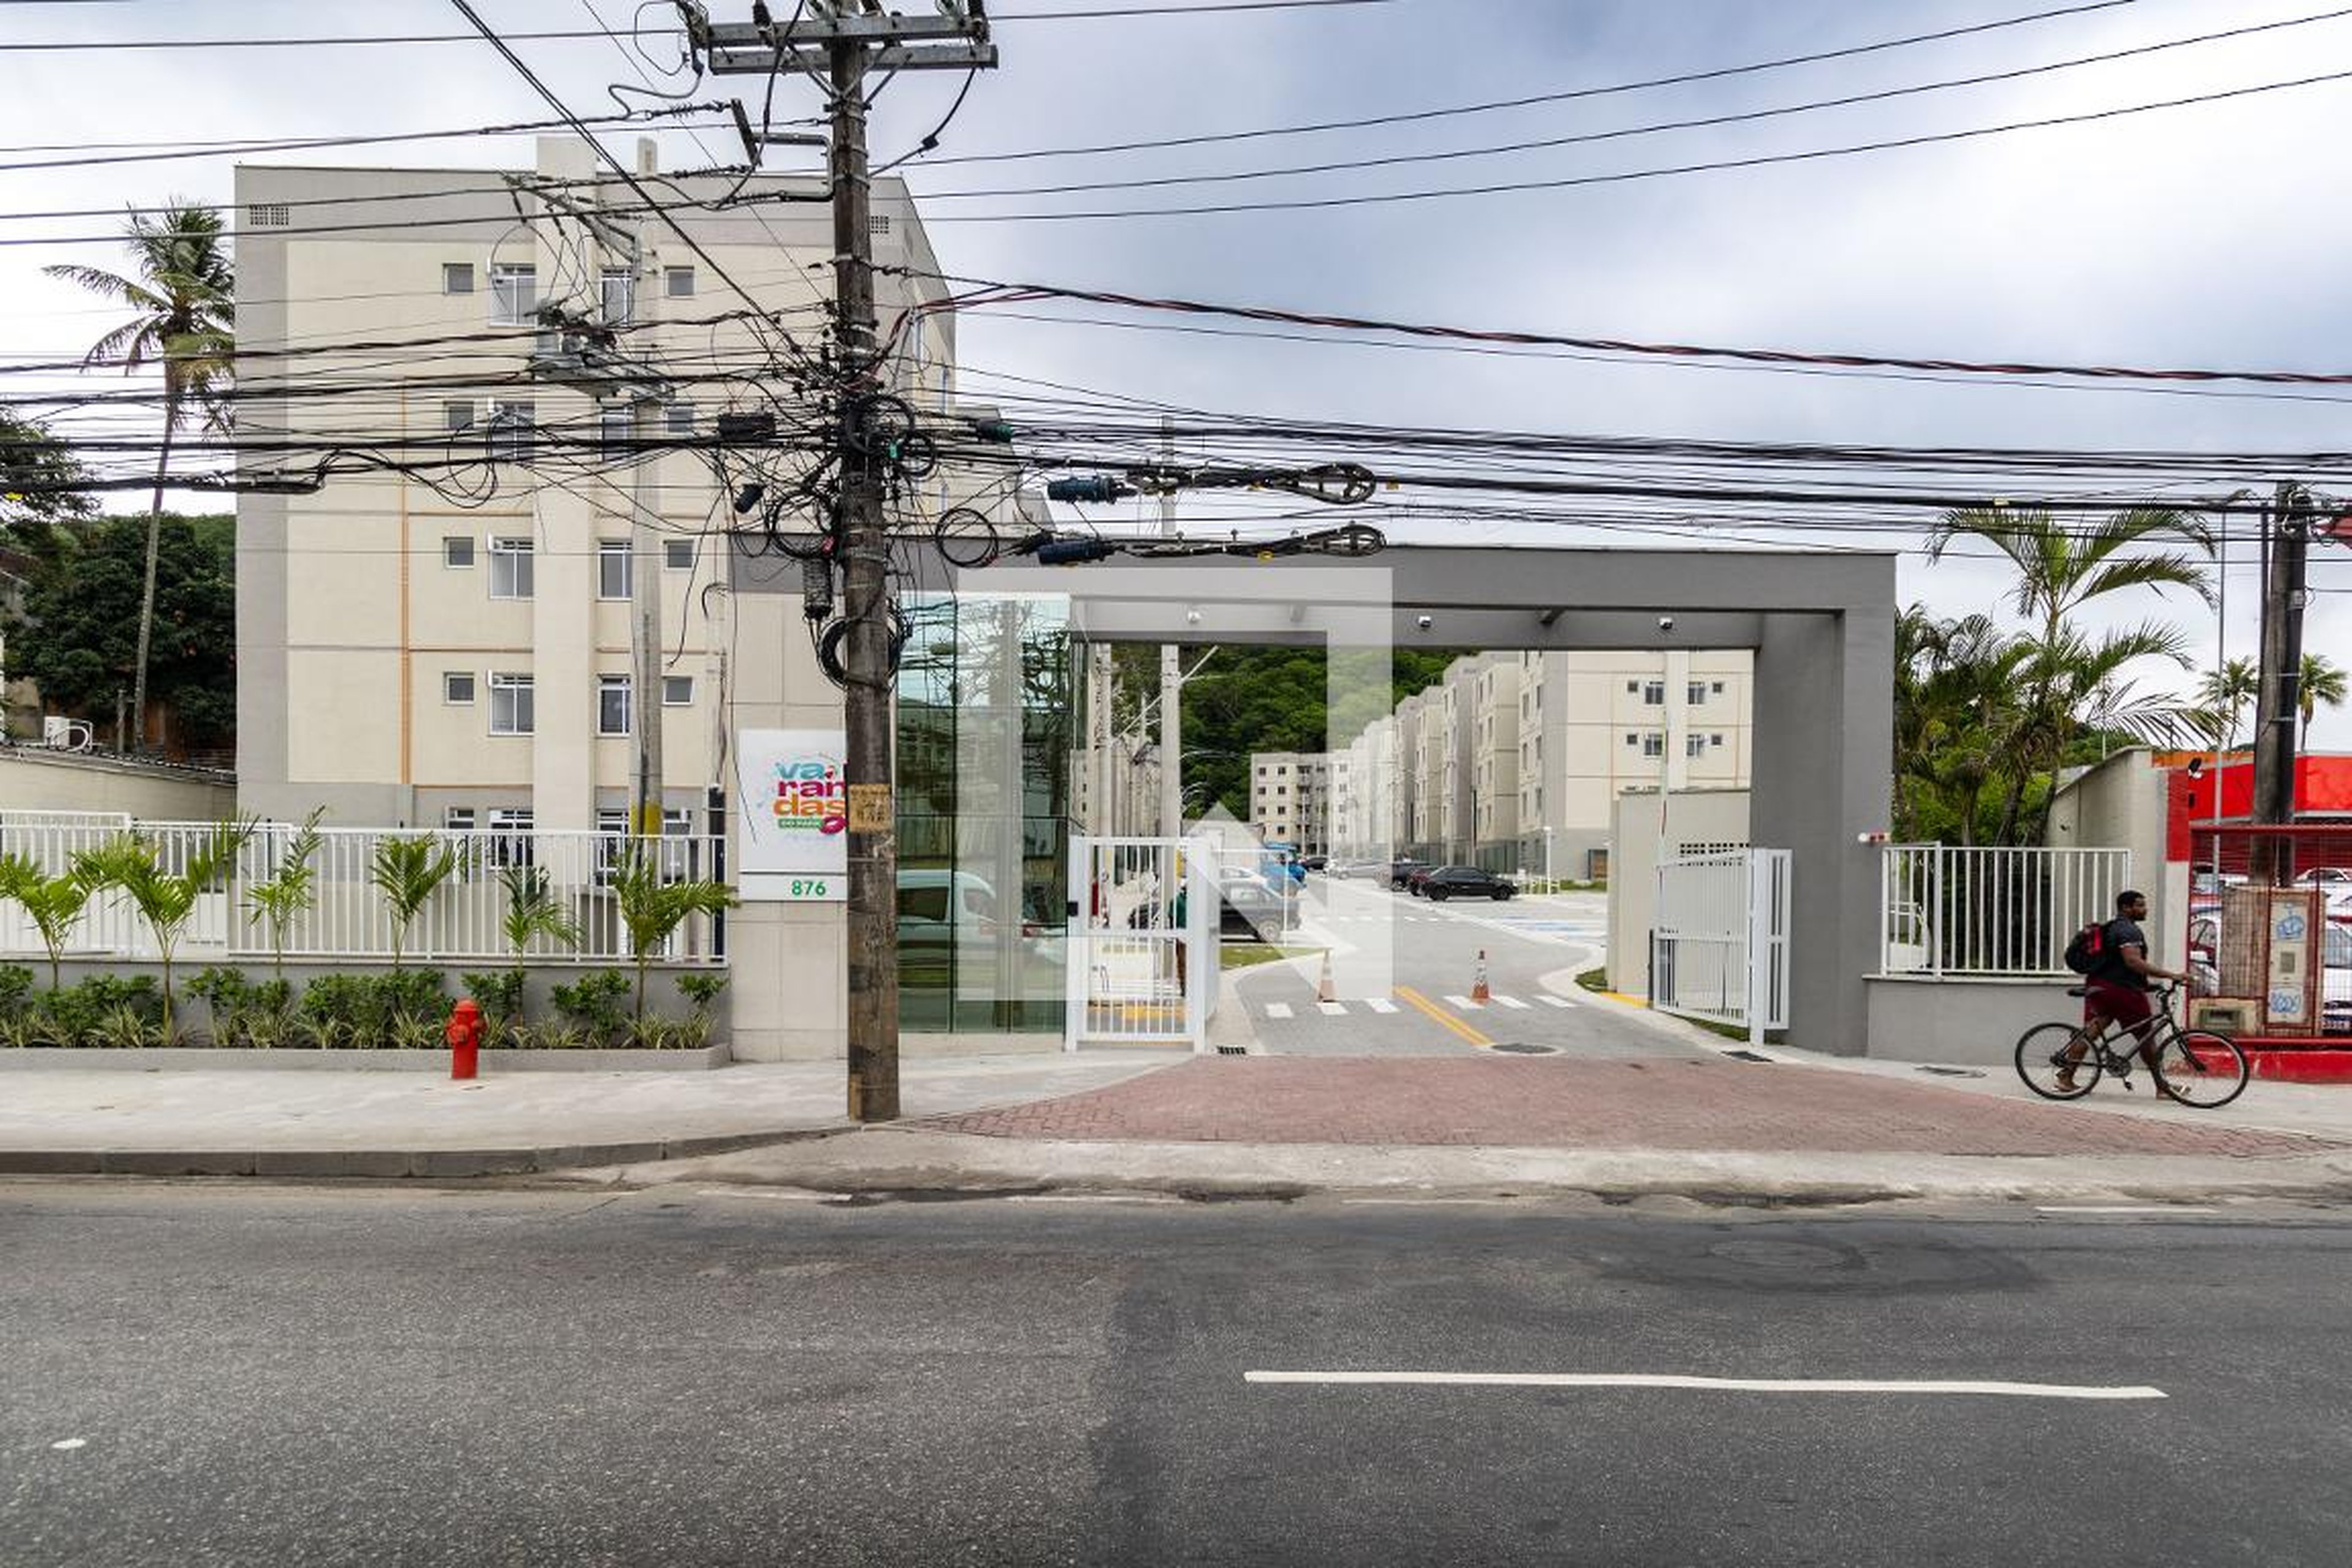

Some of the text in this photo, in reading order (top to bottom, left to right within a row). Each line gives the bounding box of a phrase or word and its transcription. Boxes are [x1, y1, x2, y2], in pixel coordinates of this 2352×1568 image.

[775, 763, 824, 779] va
[774, 793, 845, 816] das
[791, 880, 826, 895] 876
